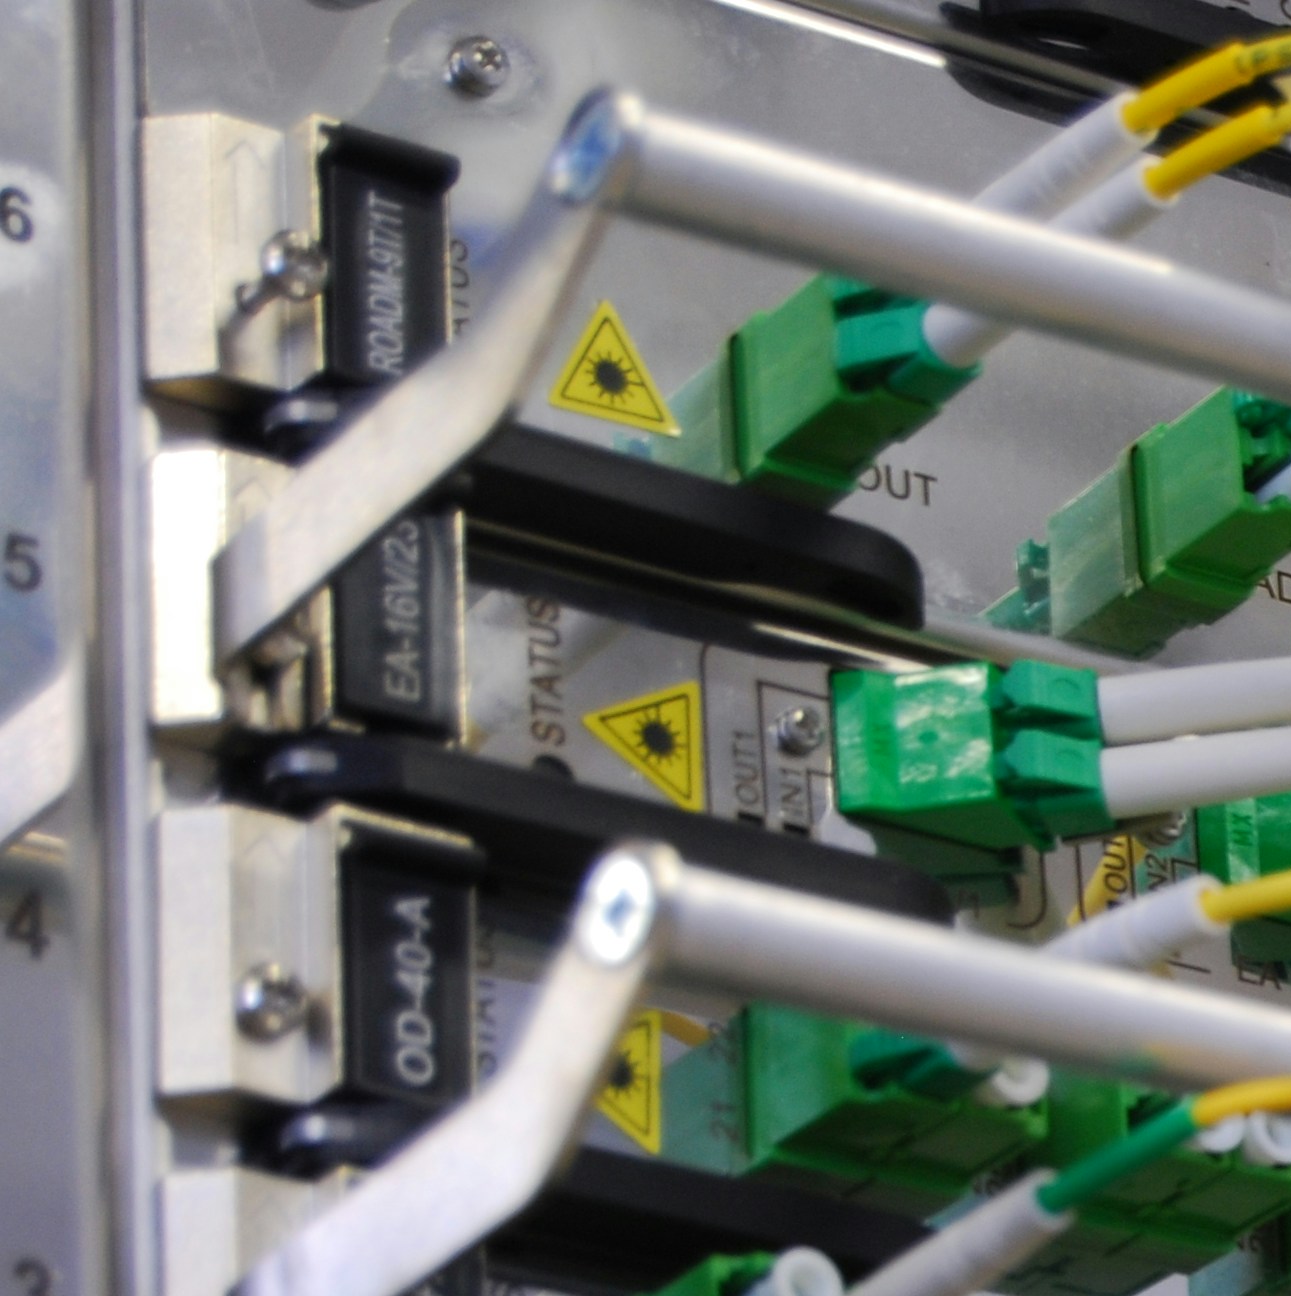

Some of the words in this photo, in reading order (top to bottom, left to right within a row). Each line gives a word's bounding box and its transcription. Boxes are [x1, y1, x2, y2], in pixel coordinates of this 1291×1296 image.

[0, 188, 33, 242] 6
[5, 535, 41, 592] 5
[9, 893, 50, 958] 4
[396, 897, 433, 1086] OD-40-A
